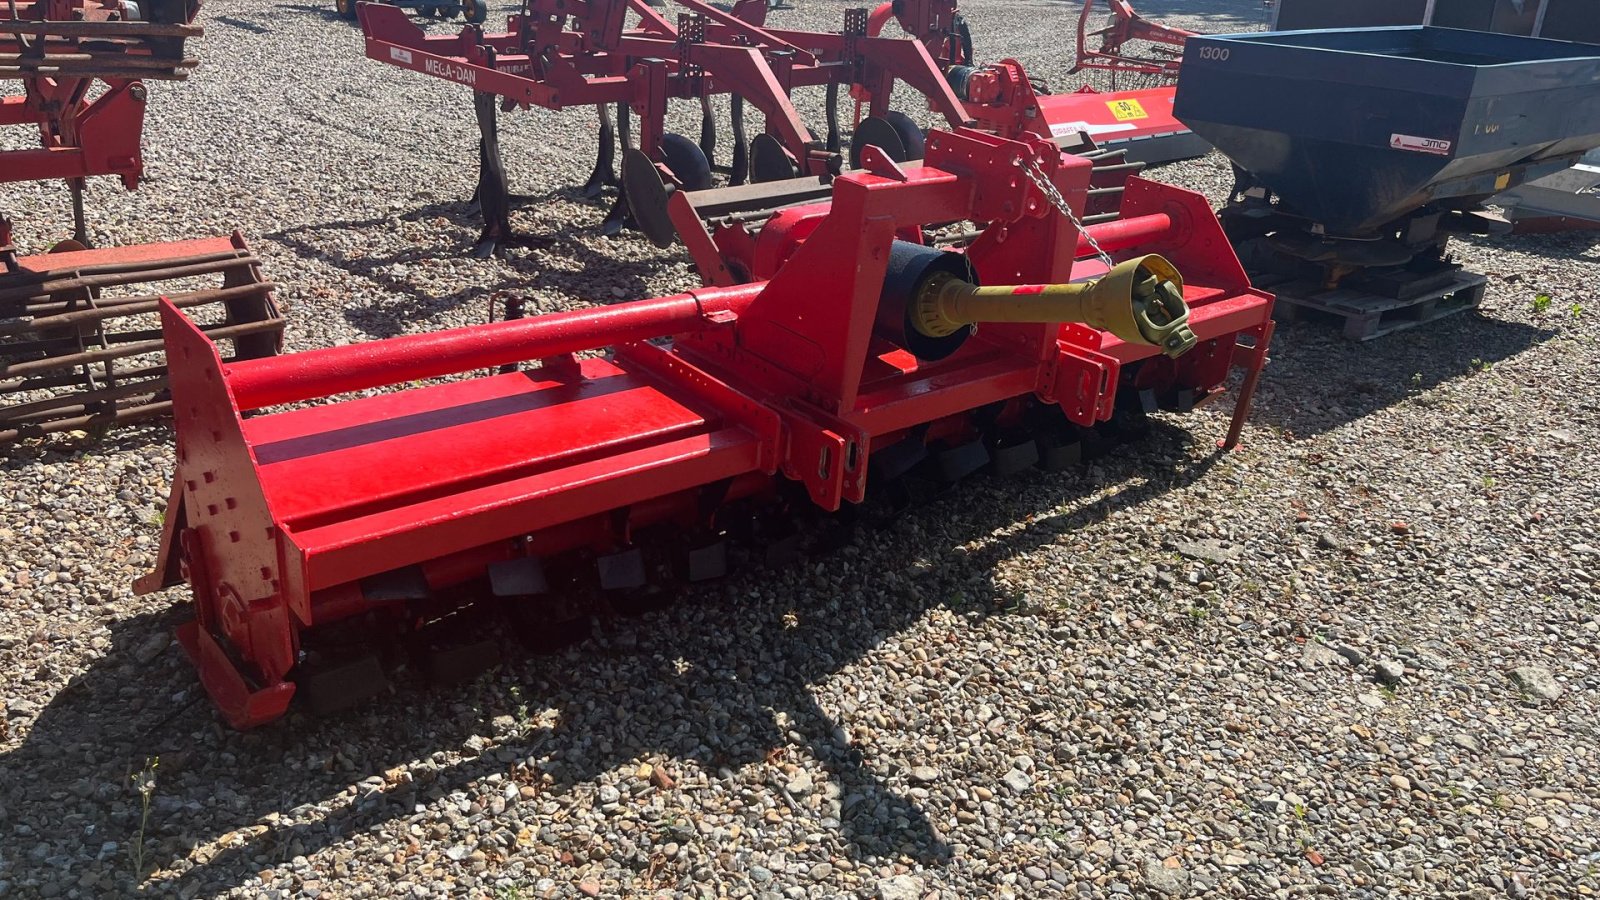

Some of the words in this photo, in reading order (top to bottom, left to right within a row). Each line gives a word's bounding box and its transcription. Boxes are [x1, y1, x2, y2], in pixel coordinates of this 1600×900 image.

[1199, 46, 1230, 61] 1300
[425, 58, 476, 84] MEGA-DAN
[1118, 101, 1131, 111] 50
[1421, 139, 1448, 149] JMC
